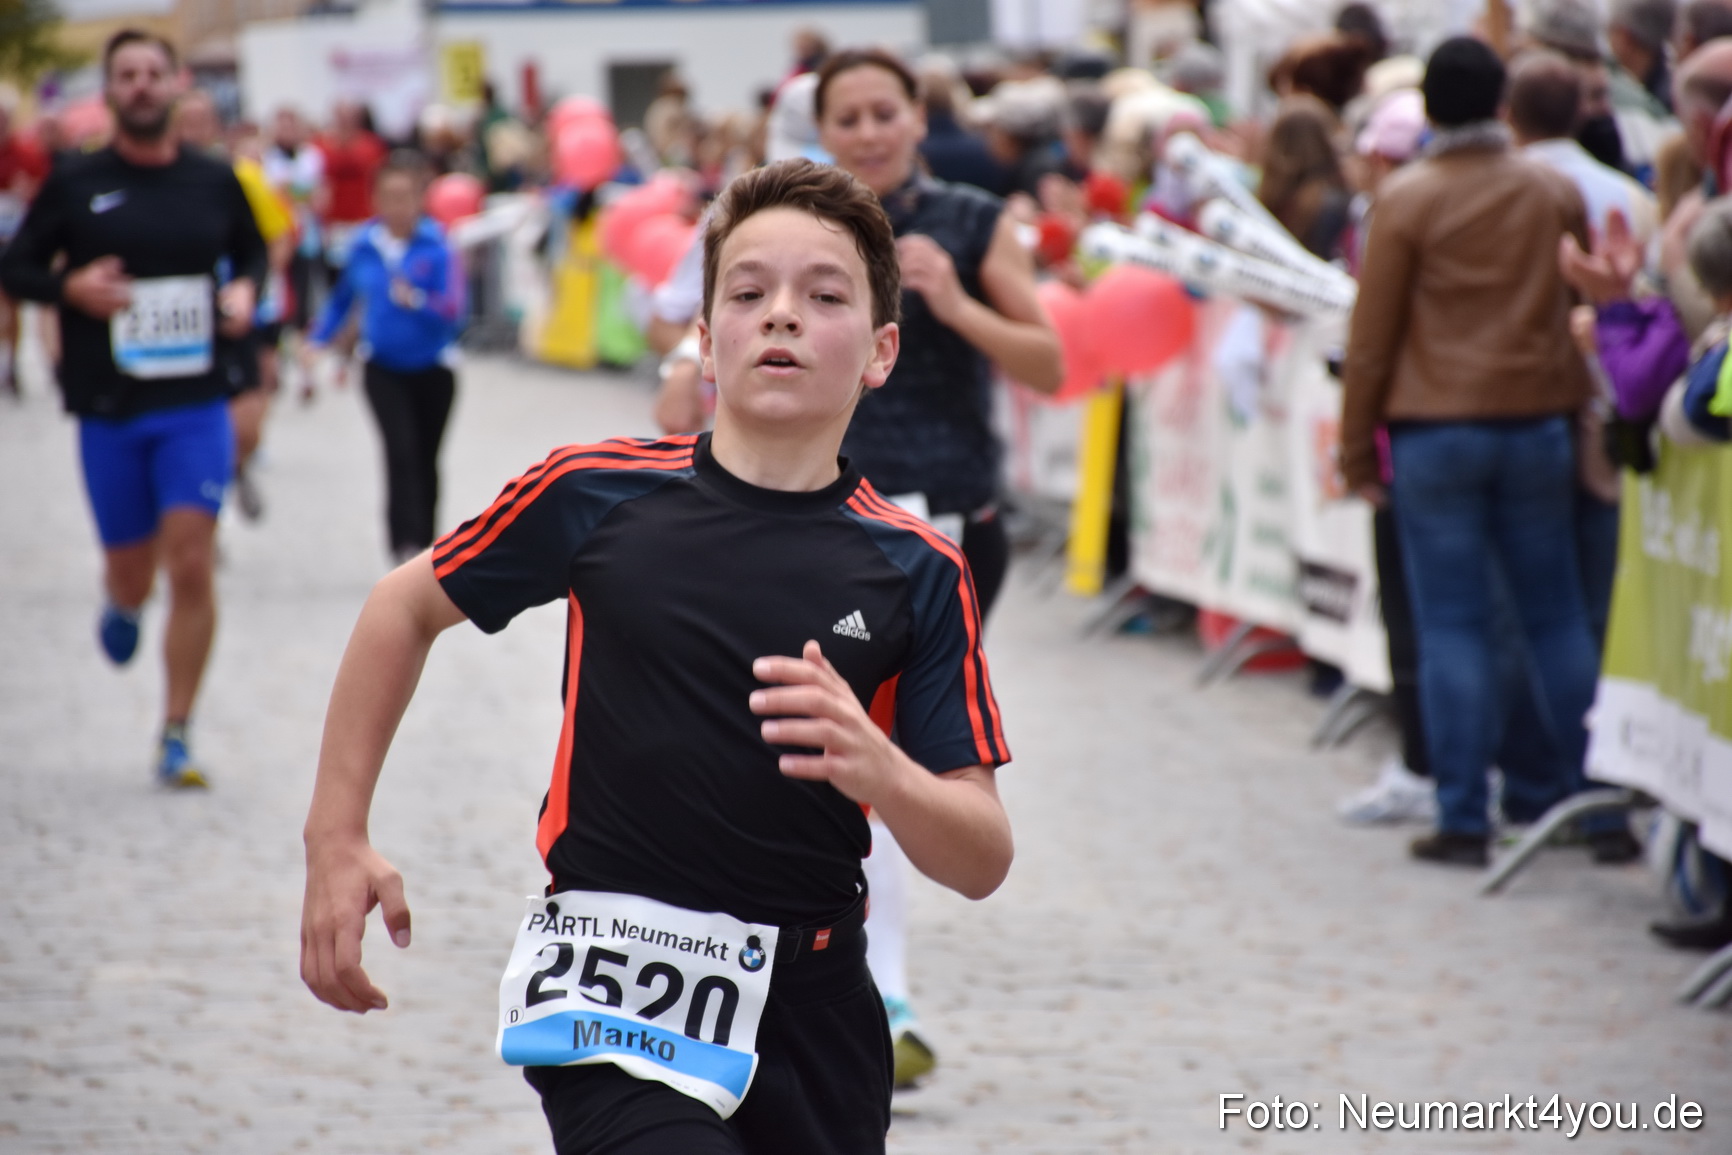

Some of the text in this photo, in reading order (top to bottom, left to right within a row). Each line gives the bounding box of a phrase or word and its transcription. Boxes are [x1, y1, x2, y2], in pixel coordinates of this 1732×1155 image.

[832, 623, 871, 641] adidas
[527, 913, 730, 962] PARTL Neumarkt
[525, 942, 740, 1047] 2520
[509, 1008, 519, 1024] D
[573, 1020, 676, 1062] Marko
